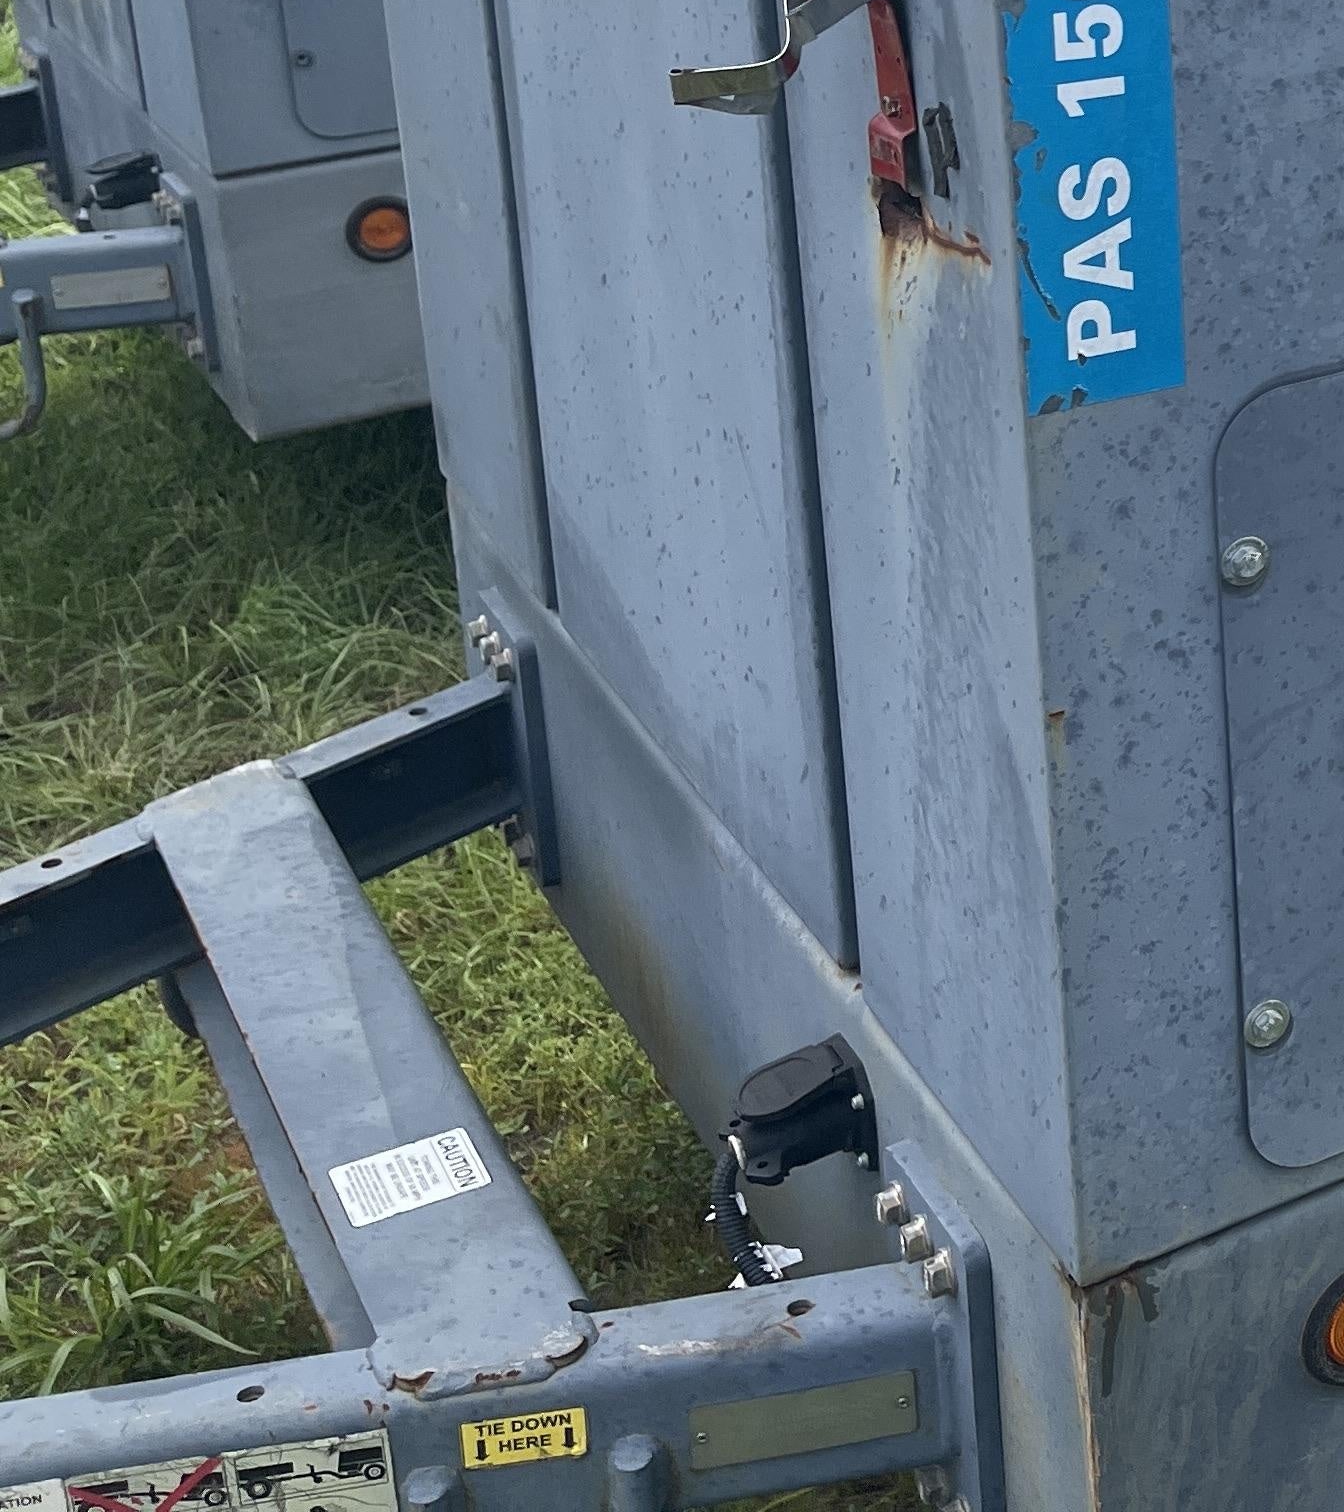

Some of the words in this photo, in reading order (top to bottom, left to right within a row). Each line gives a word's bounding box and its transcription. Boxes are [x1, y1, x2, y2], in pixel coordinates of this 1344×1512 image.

[1057, 155, 1138, 362] PAS
[437, 1136, 479, 1188] CAUTION
[475, 1422, 505, 1437] TIE
[511, 1413, 571, 1433] DOWN
[499, 1434, 552, 1452] HERE
